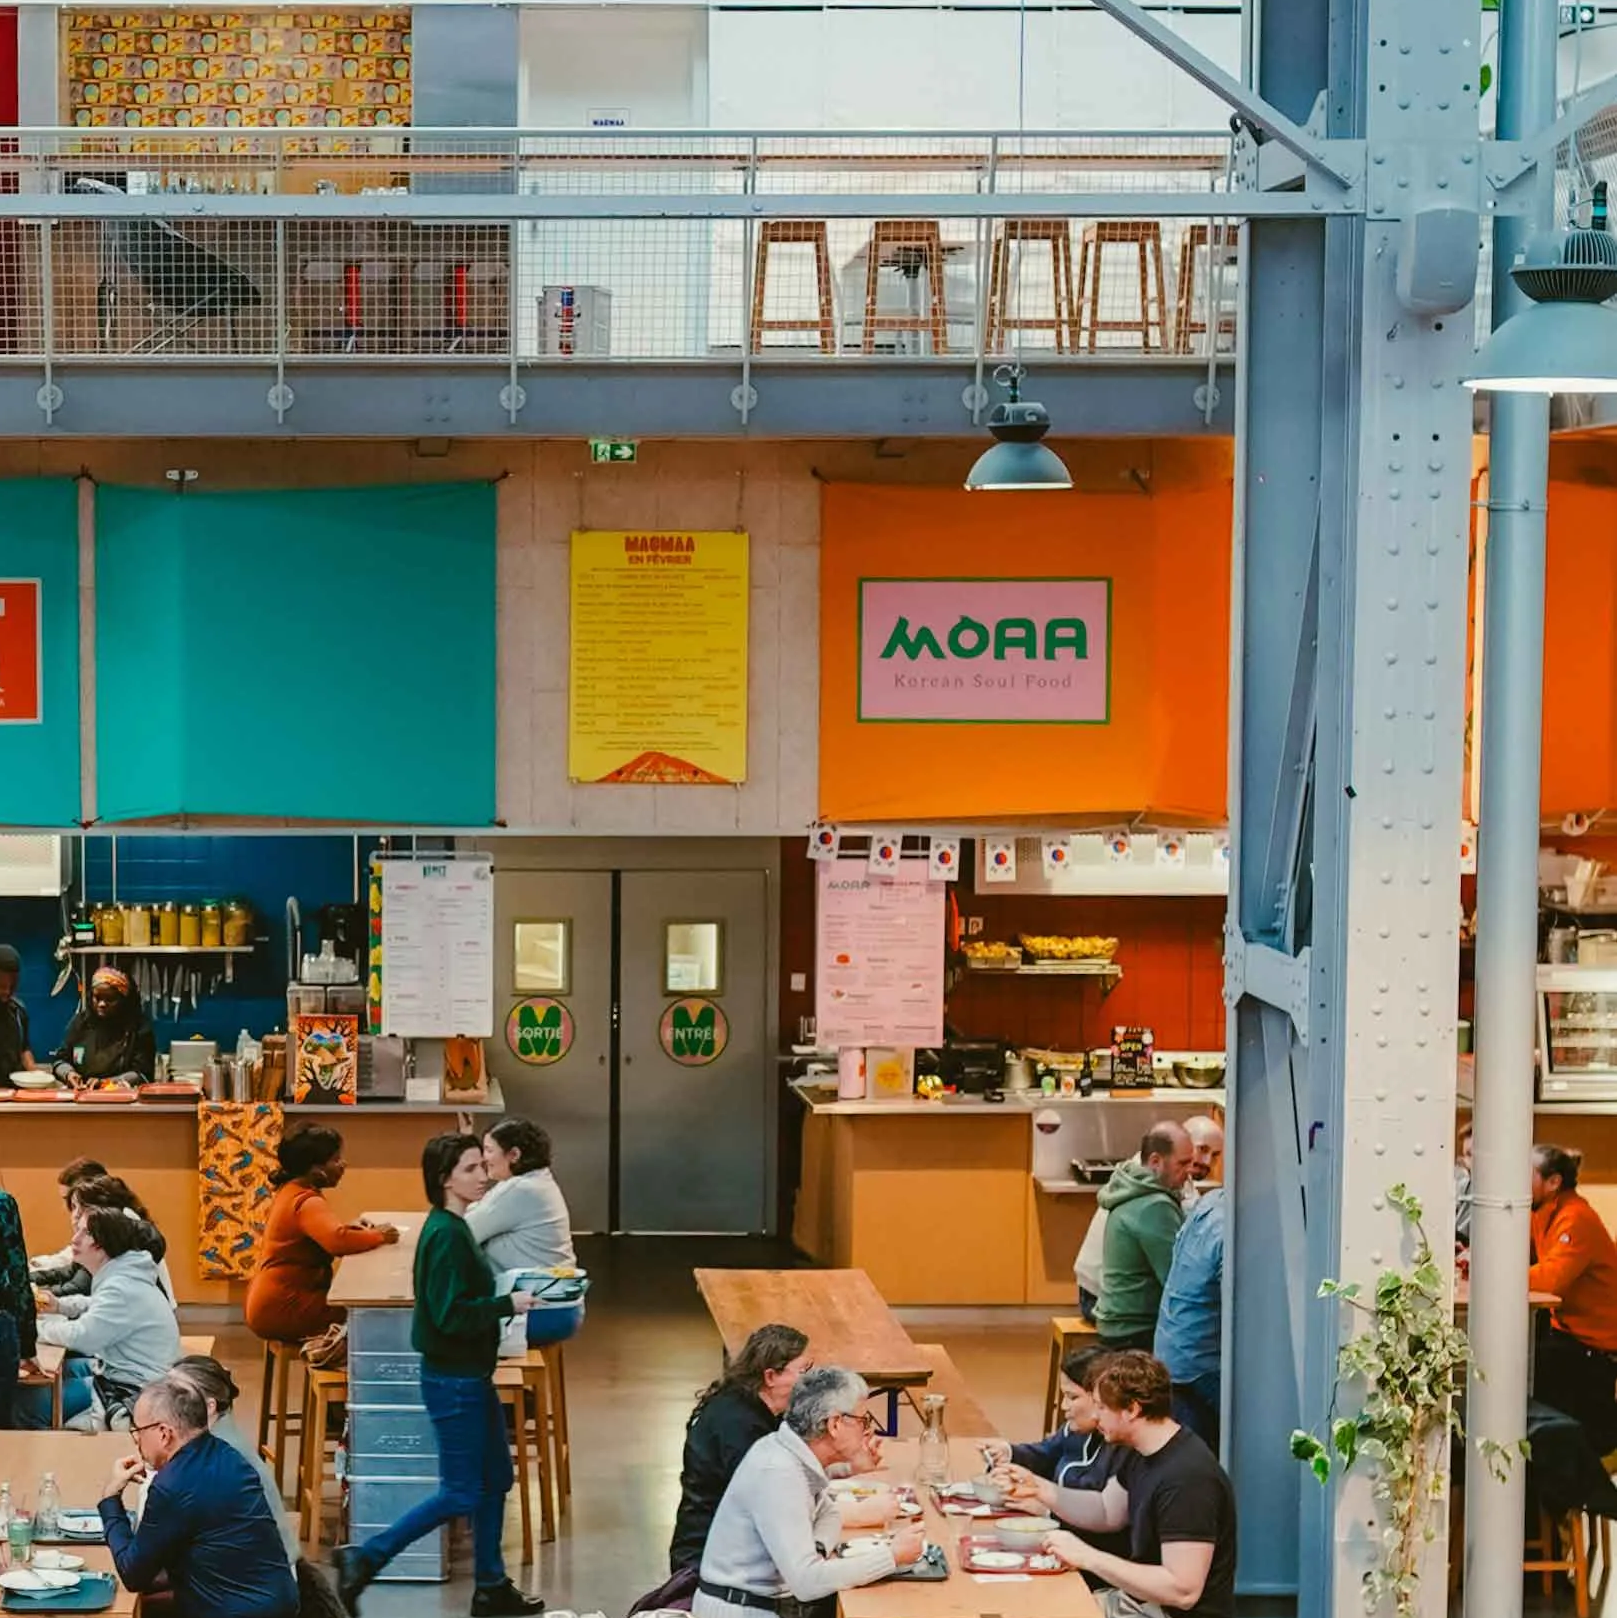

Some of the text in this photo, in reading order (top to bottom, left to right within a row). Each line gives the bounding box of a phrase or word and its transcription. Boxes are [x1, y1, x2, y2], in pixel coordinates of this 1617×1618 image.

[624, 536, 695, 553] MAGMAA
[628, 553, 692, 565] EN FÉVRIER
[879, 615, 1088, 661] MOAA
[894, 674, 1073, 689] Korean Soul Food
[513, 1025, 563, 1040] SORTIE
